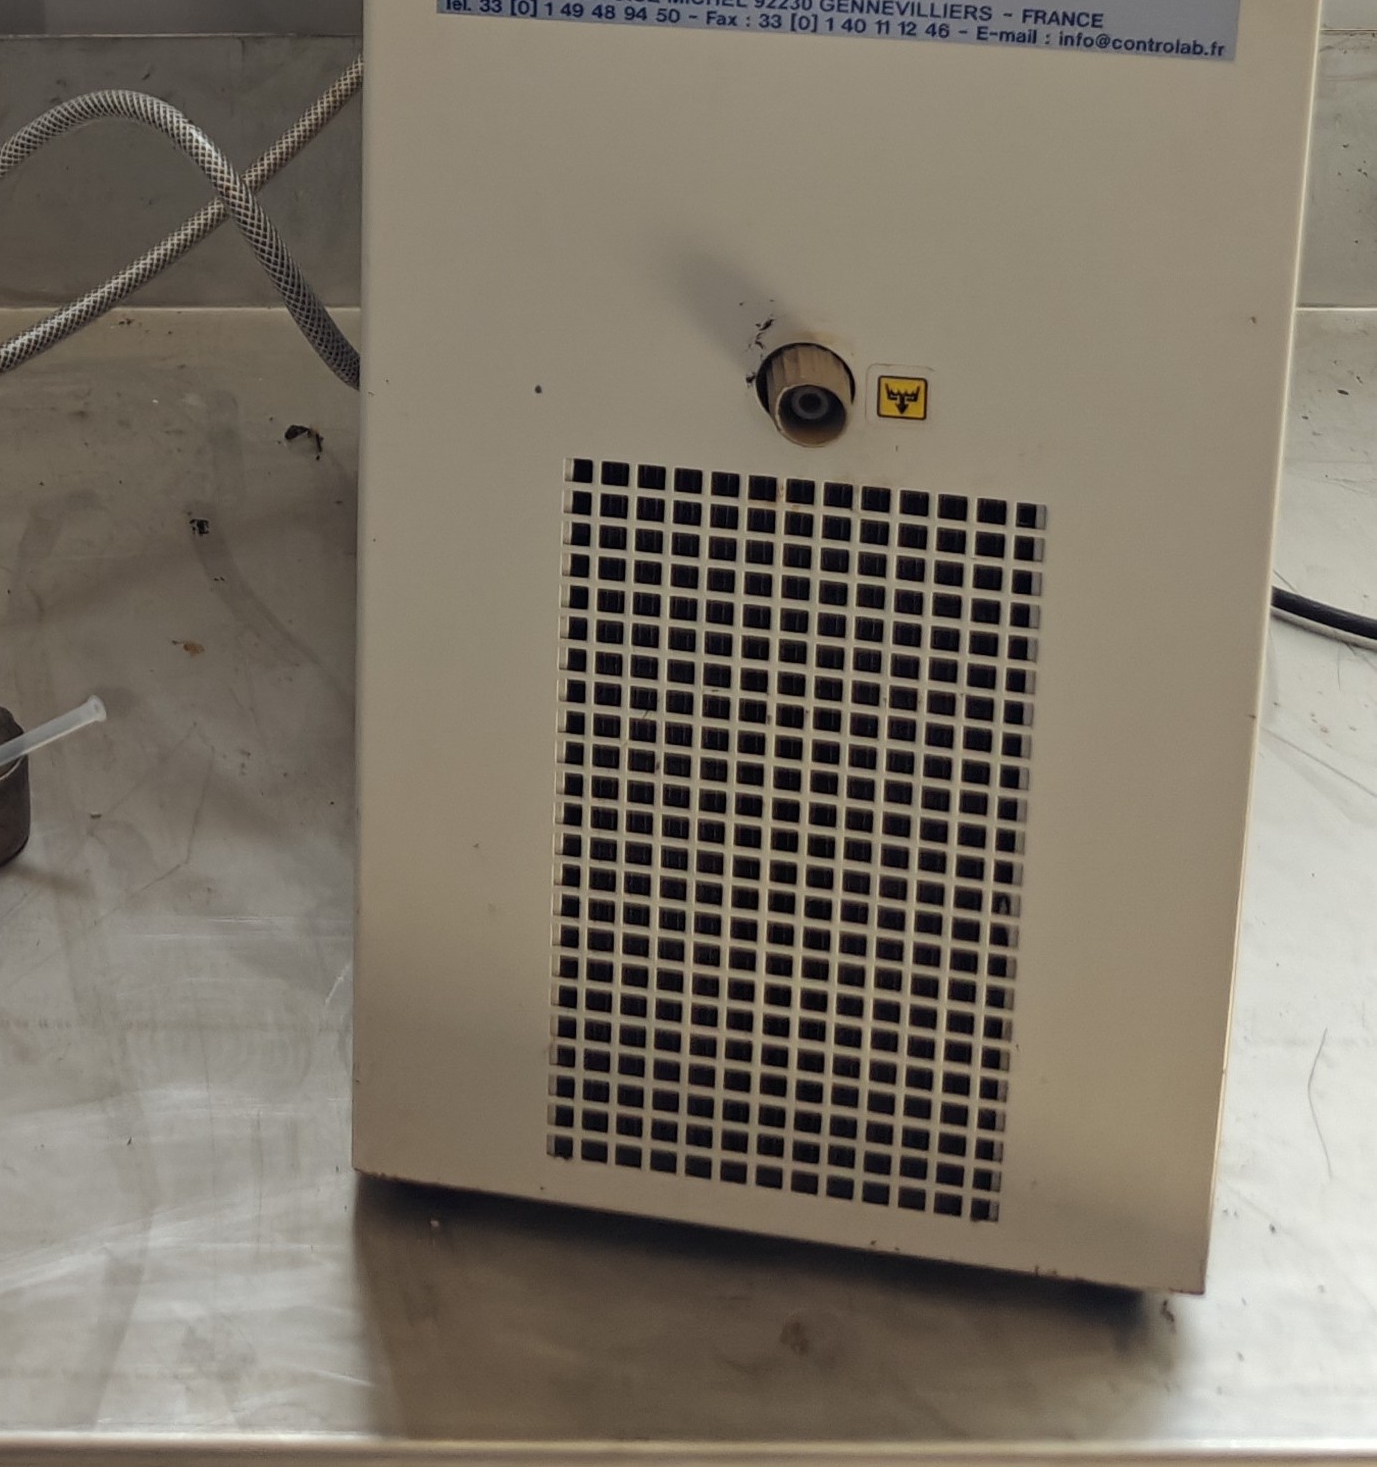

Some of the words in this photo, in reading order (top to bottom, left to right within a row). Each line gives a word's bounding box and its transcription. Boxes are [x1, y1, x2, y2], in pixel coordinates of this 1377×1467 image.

[546, 2, 553, 16] 1
[561, 2, 584, 17] 49
[592, 5, 616, 20] 48
[624, 7, 647, 22] 94
[657, 9, 680, 24] 50
[706, 11, 737, 27] Fax
[758, 14, 782, 29] 33
[826, 20, 834, 32] 1
[841, 20, 866, 34] 40
[876, 21, 890, 34] 11
[898, 21, 917, 36] 12
[925, 24, 950, 39] 46
[976, 27, 1037, 45] E-mail
[1059, 33, 1225, 57] info@controlab.fr
[1023, 9, 1104, 28] FRANCE
